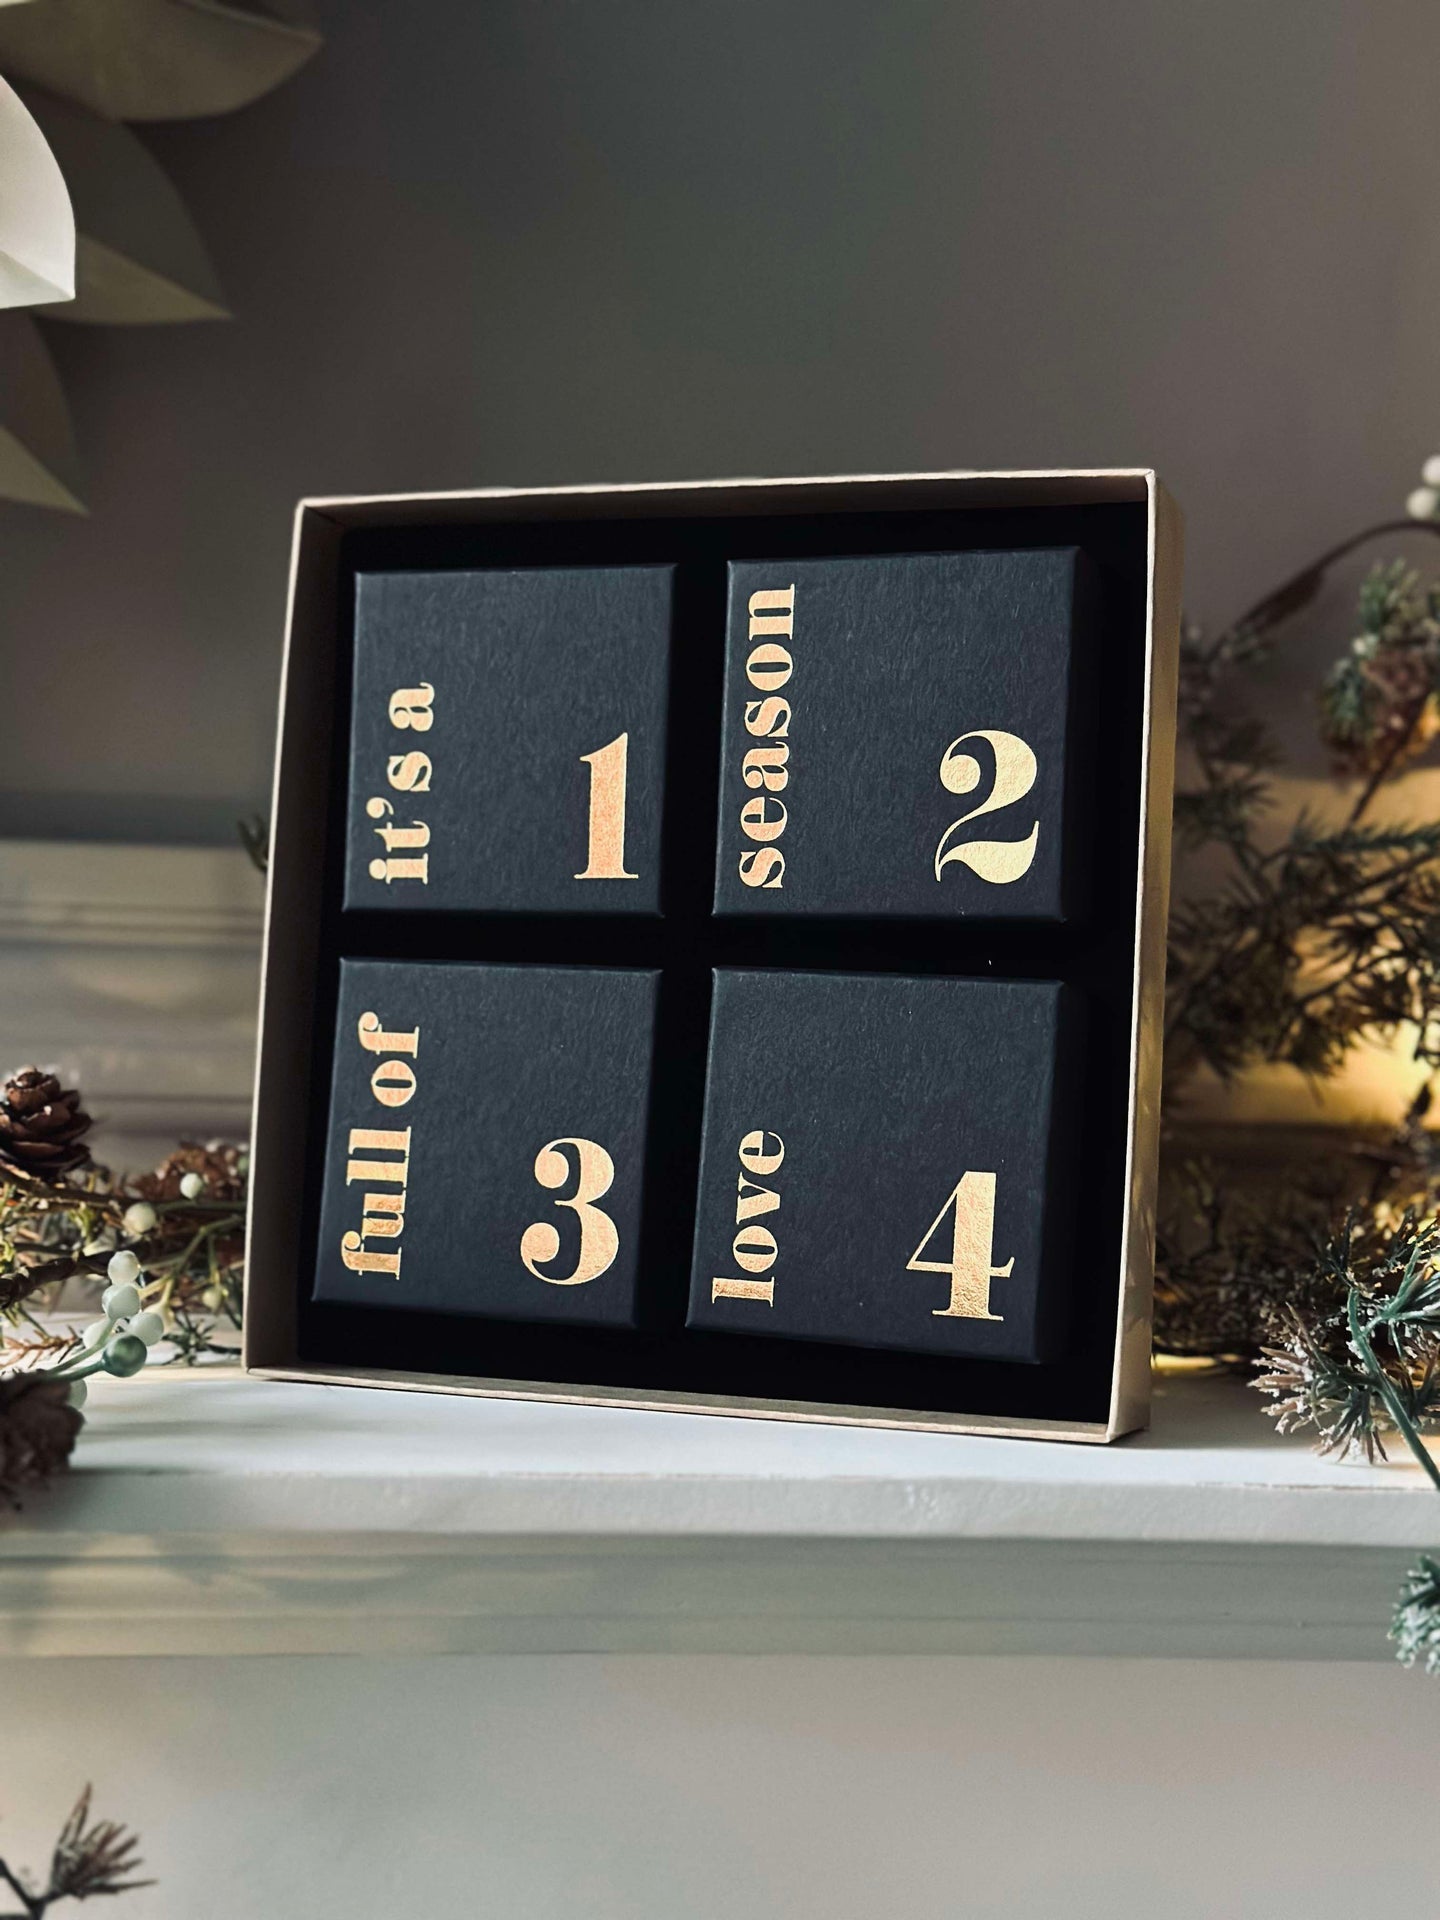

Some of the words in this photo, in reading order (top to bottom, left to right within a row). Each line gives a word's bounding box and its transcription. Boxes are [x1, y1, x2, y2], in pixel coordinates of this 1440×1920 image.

[387, 682, 436, 732] a
[738, 584, 796, 890] season
[574, 727, 640, 881] 1
[935, 729, 1040, 884] 2
[357, 1011, 420, 1108] of
[340, 1127, 412, 1280] full
[519, 1137, 620, 1287] 3
[711, 1130, 786, 1309] love
[905, 1170, 1016, 1322] 4
